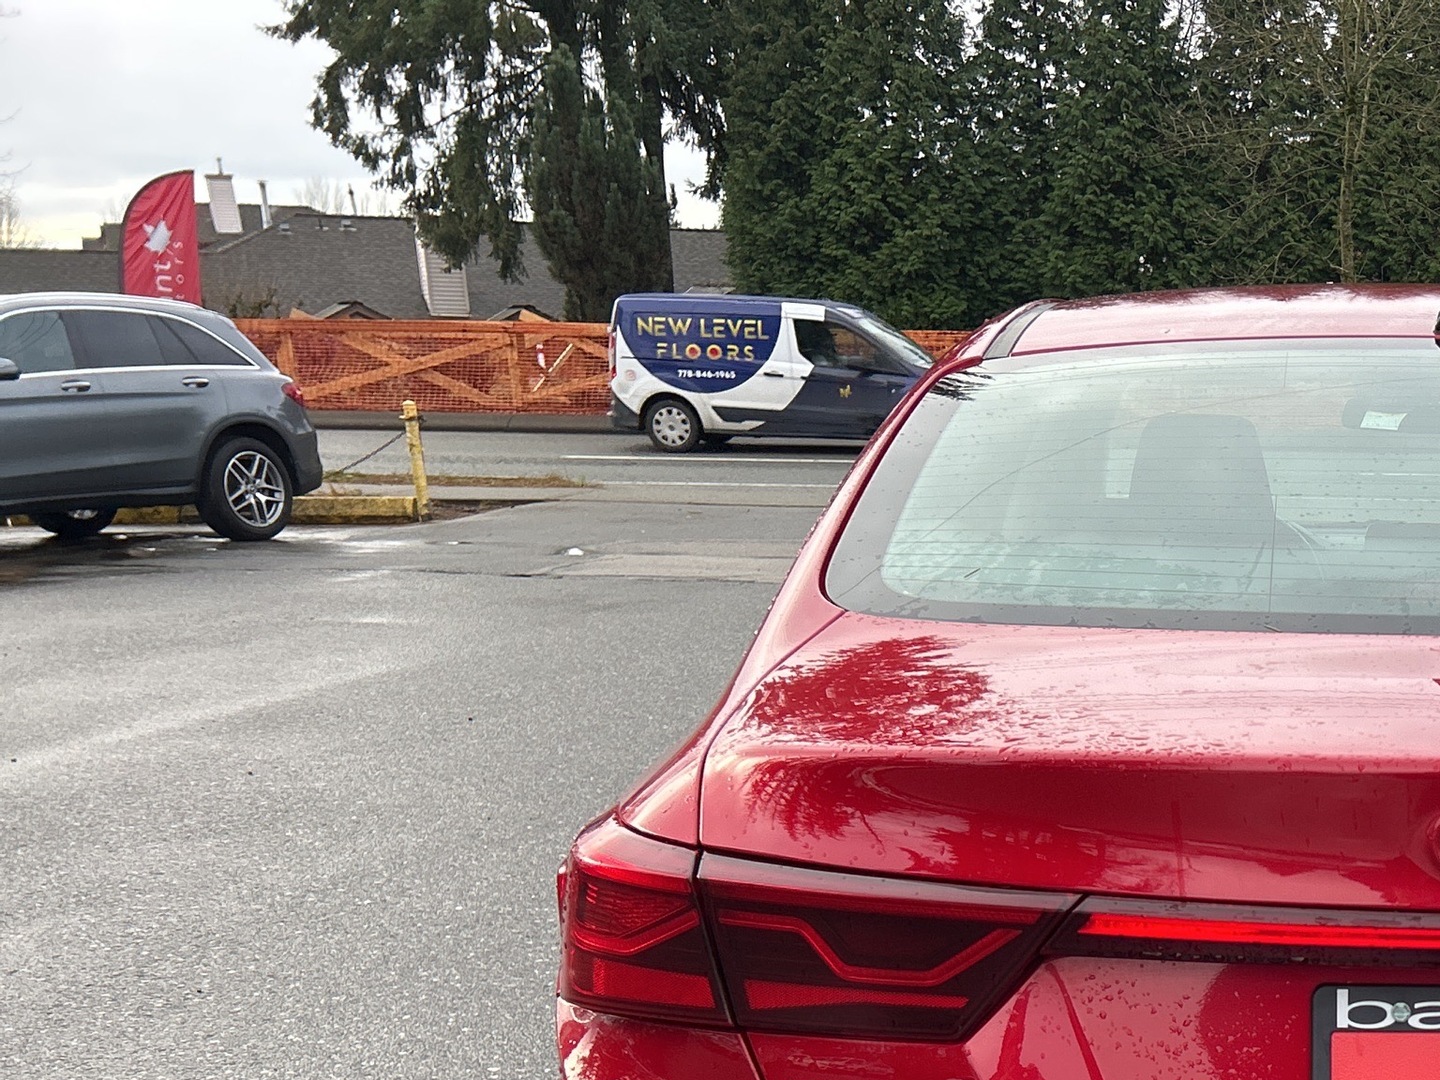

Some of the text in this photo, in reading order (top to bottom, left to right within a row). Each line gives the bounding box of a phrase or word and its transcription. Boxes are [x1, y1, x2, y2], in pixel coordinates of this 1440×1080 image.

[636, 316, 769, 340] NEW LEVEL
[656, 342, 755, 361] FLOORS
